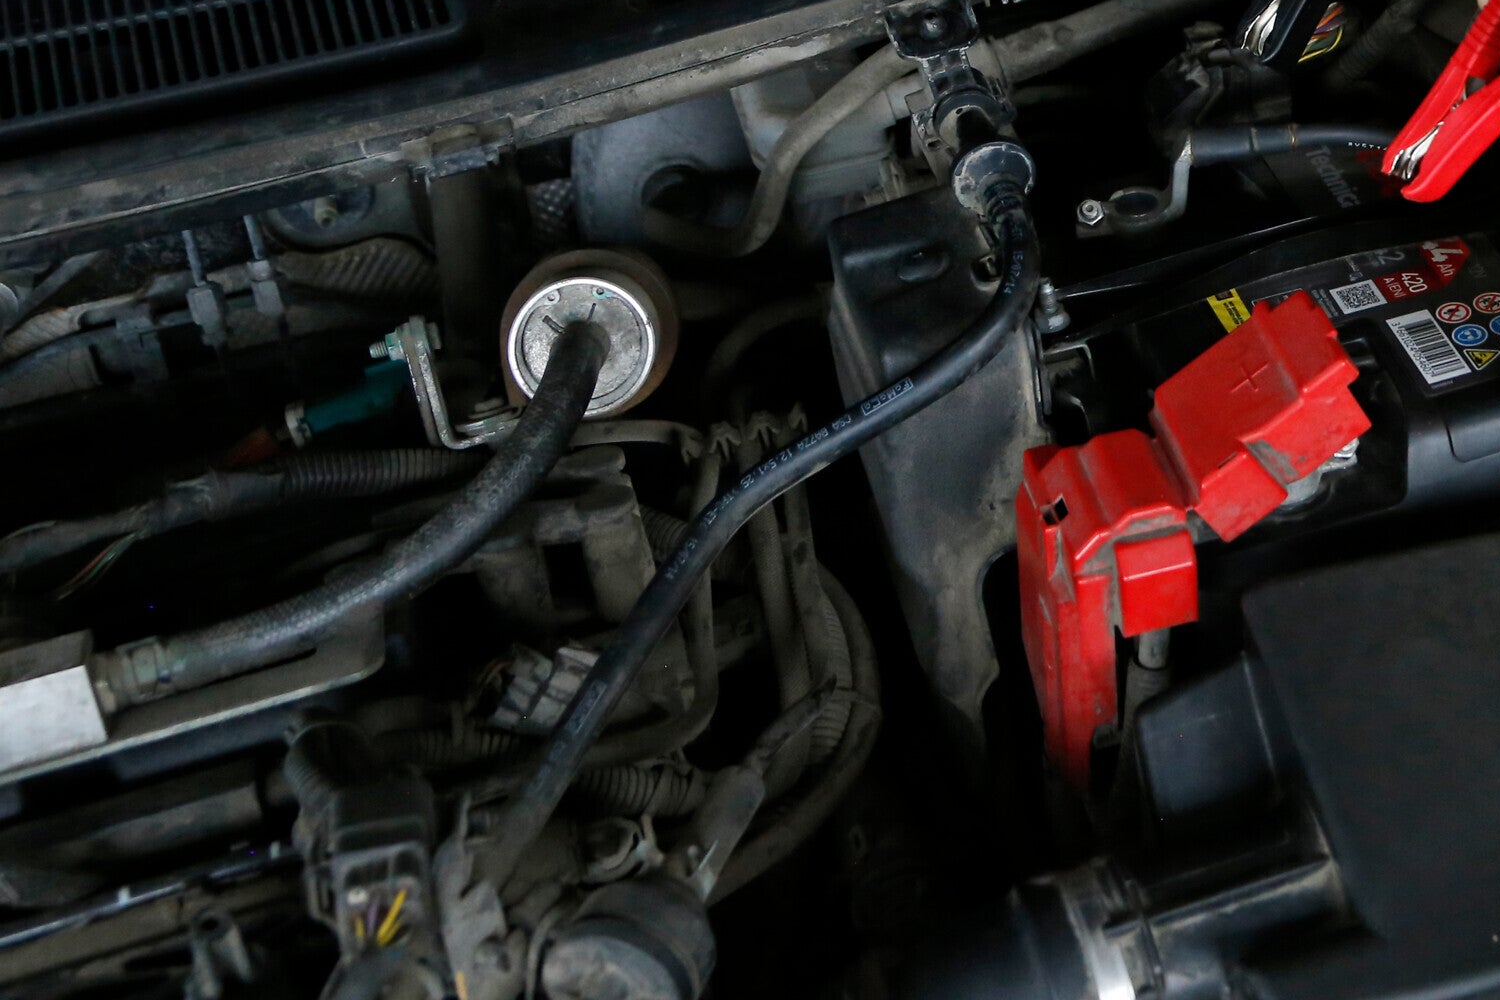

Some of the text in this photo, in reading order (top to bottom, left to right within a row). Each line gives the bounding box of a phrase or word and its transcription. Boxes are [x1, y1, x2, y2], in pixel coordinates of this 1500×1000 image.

[1305, 145, 1361, 209] Technic
[1436, 261, 1457, 277] Ah
[1401, 272, 1428, 293] 420
